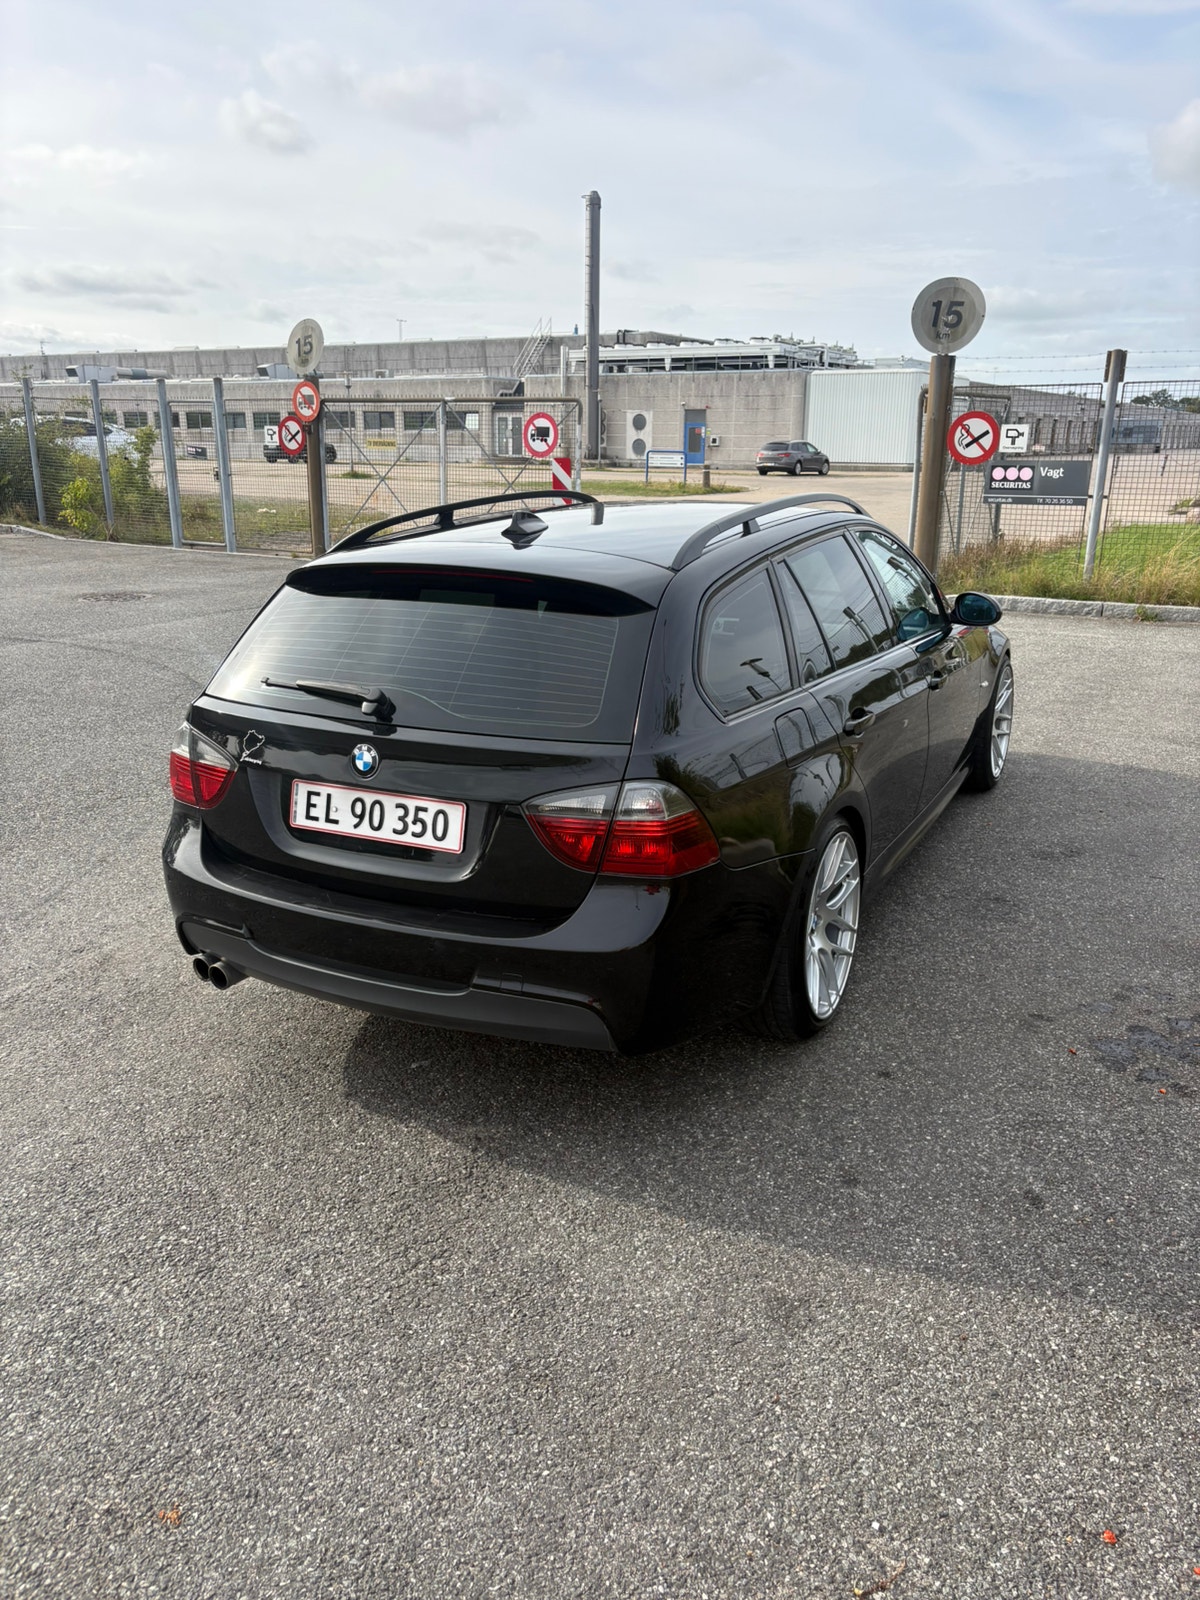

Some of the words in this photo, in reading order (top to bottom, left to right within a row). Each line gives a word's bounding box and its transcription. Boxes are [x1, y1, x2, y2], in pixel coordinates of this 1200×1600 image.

[931, 300, 965, 328] 15
[935, 331, 950, 340] km
[295, 334, 313, 357] 15
[1040, 466, 1064, 479] Vagt
[991, 481, 1031, 489] SECURITAS
[353, 745, 377, 757] BMW
[305, 790, 340, 825] EL
[350, 797, 385, 831] 90
[392, 803, 449, 842] 350
